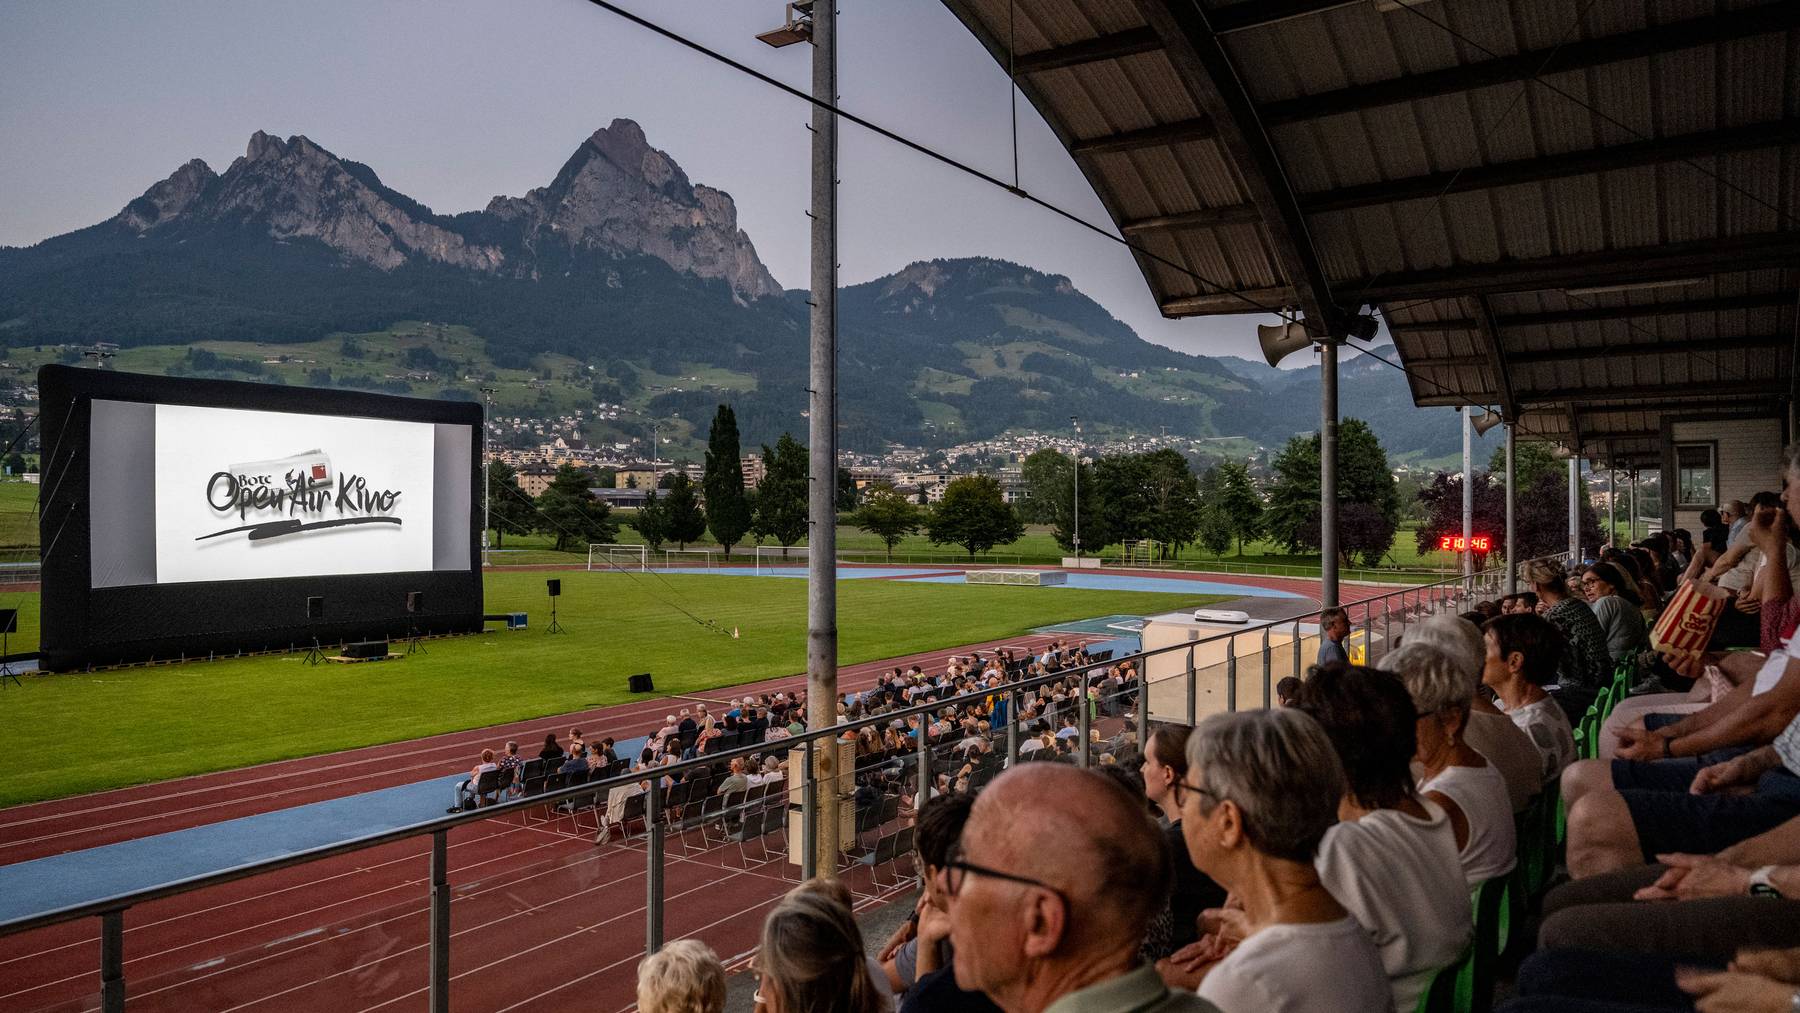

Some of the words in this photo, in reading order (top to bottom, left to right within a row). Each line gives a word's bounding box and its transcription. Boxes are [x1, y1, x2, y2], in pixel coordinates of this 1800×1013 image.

[207, 471, 284, 521] Open
[287, 470, 332, 517] Air
[335, 471, 402, 514] Kino
